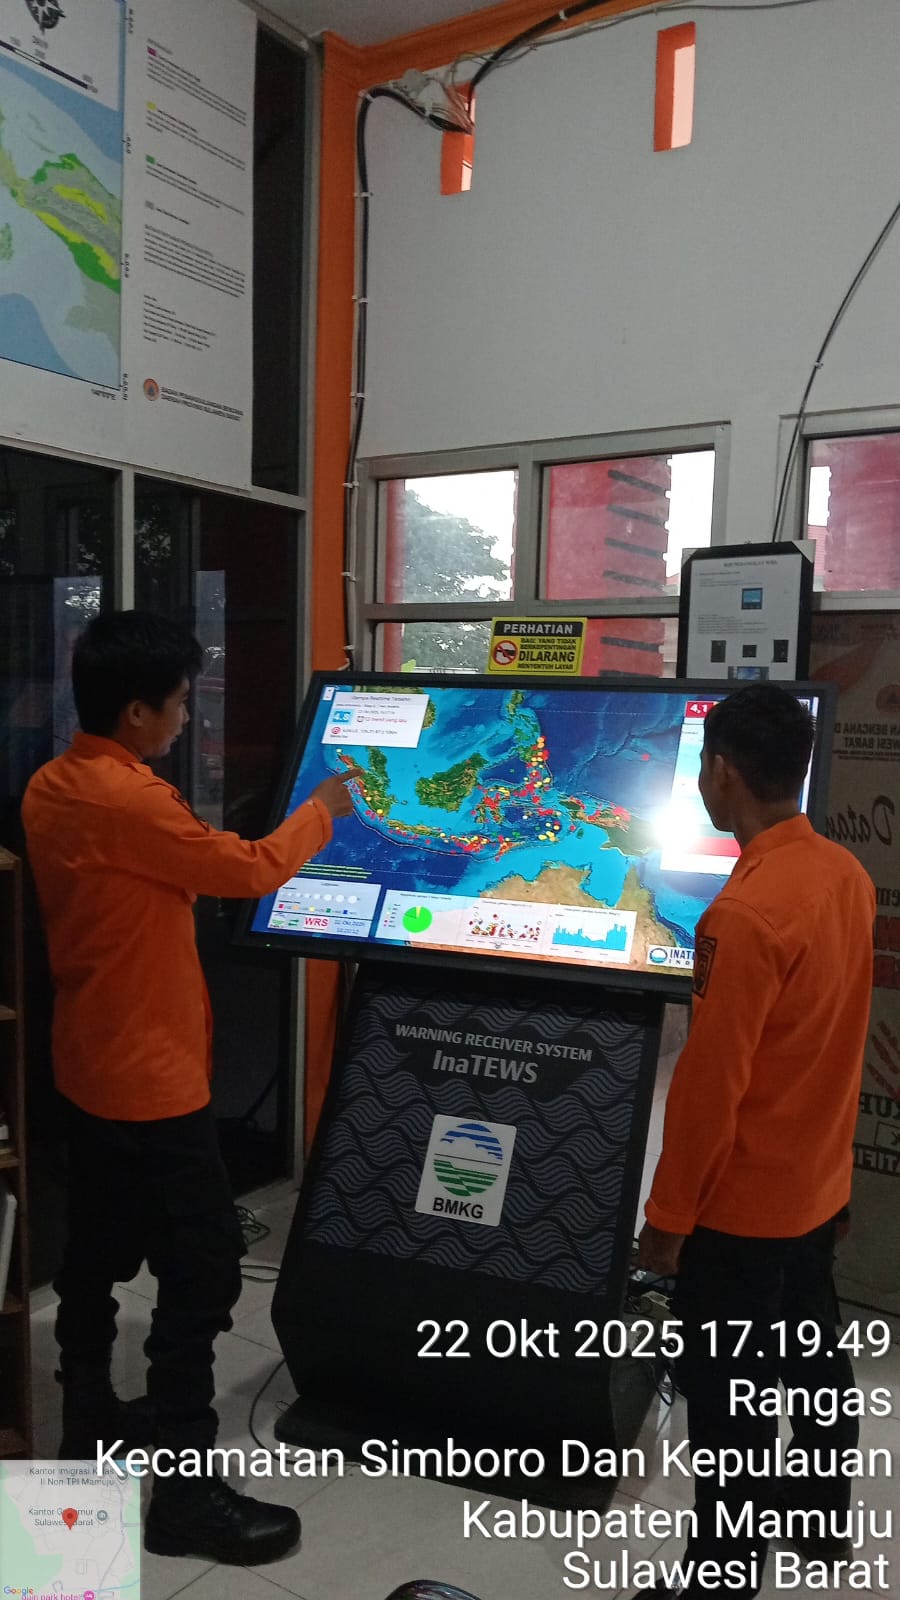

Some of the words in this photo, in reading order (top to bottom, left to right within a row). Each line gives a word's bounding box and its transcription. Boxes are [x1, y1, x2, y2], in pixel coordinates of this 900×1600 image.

[503, 623, 573, 635] PERHATIAN
[519, 650, 575, 663] DILARANG
[304, 917, 329, 927] WRS
[395, 1023, 463, 1044] WARNING
[465, 1033, 533, 1054] RECEIVER
[535, 1042, 593, 1062] SYSTEM
[431, 1049, 540, 1084] InaTEWS
[432, 1196, 484, 1220] BMKG
